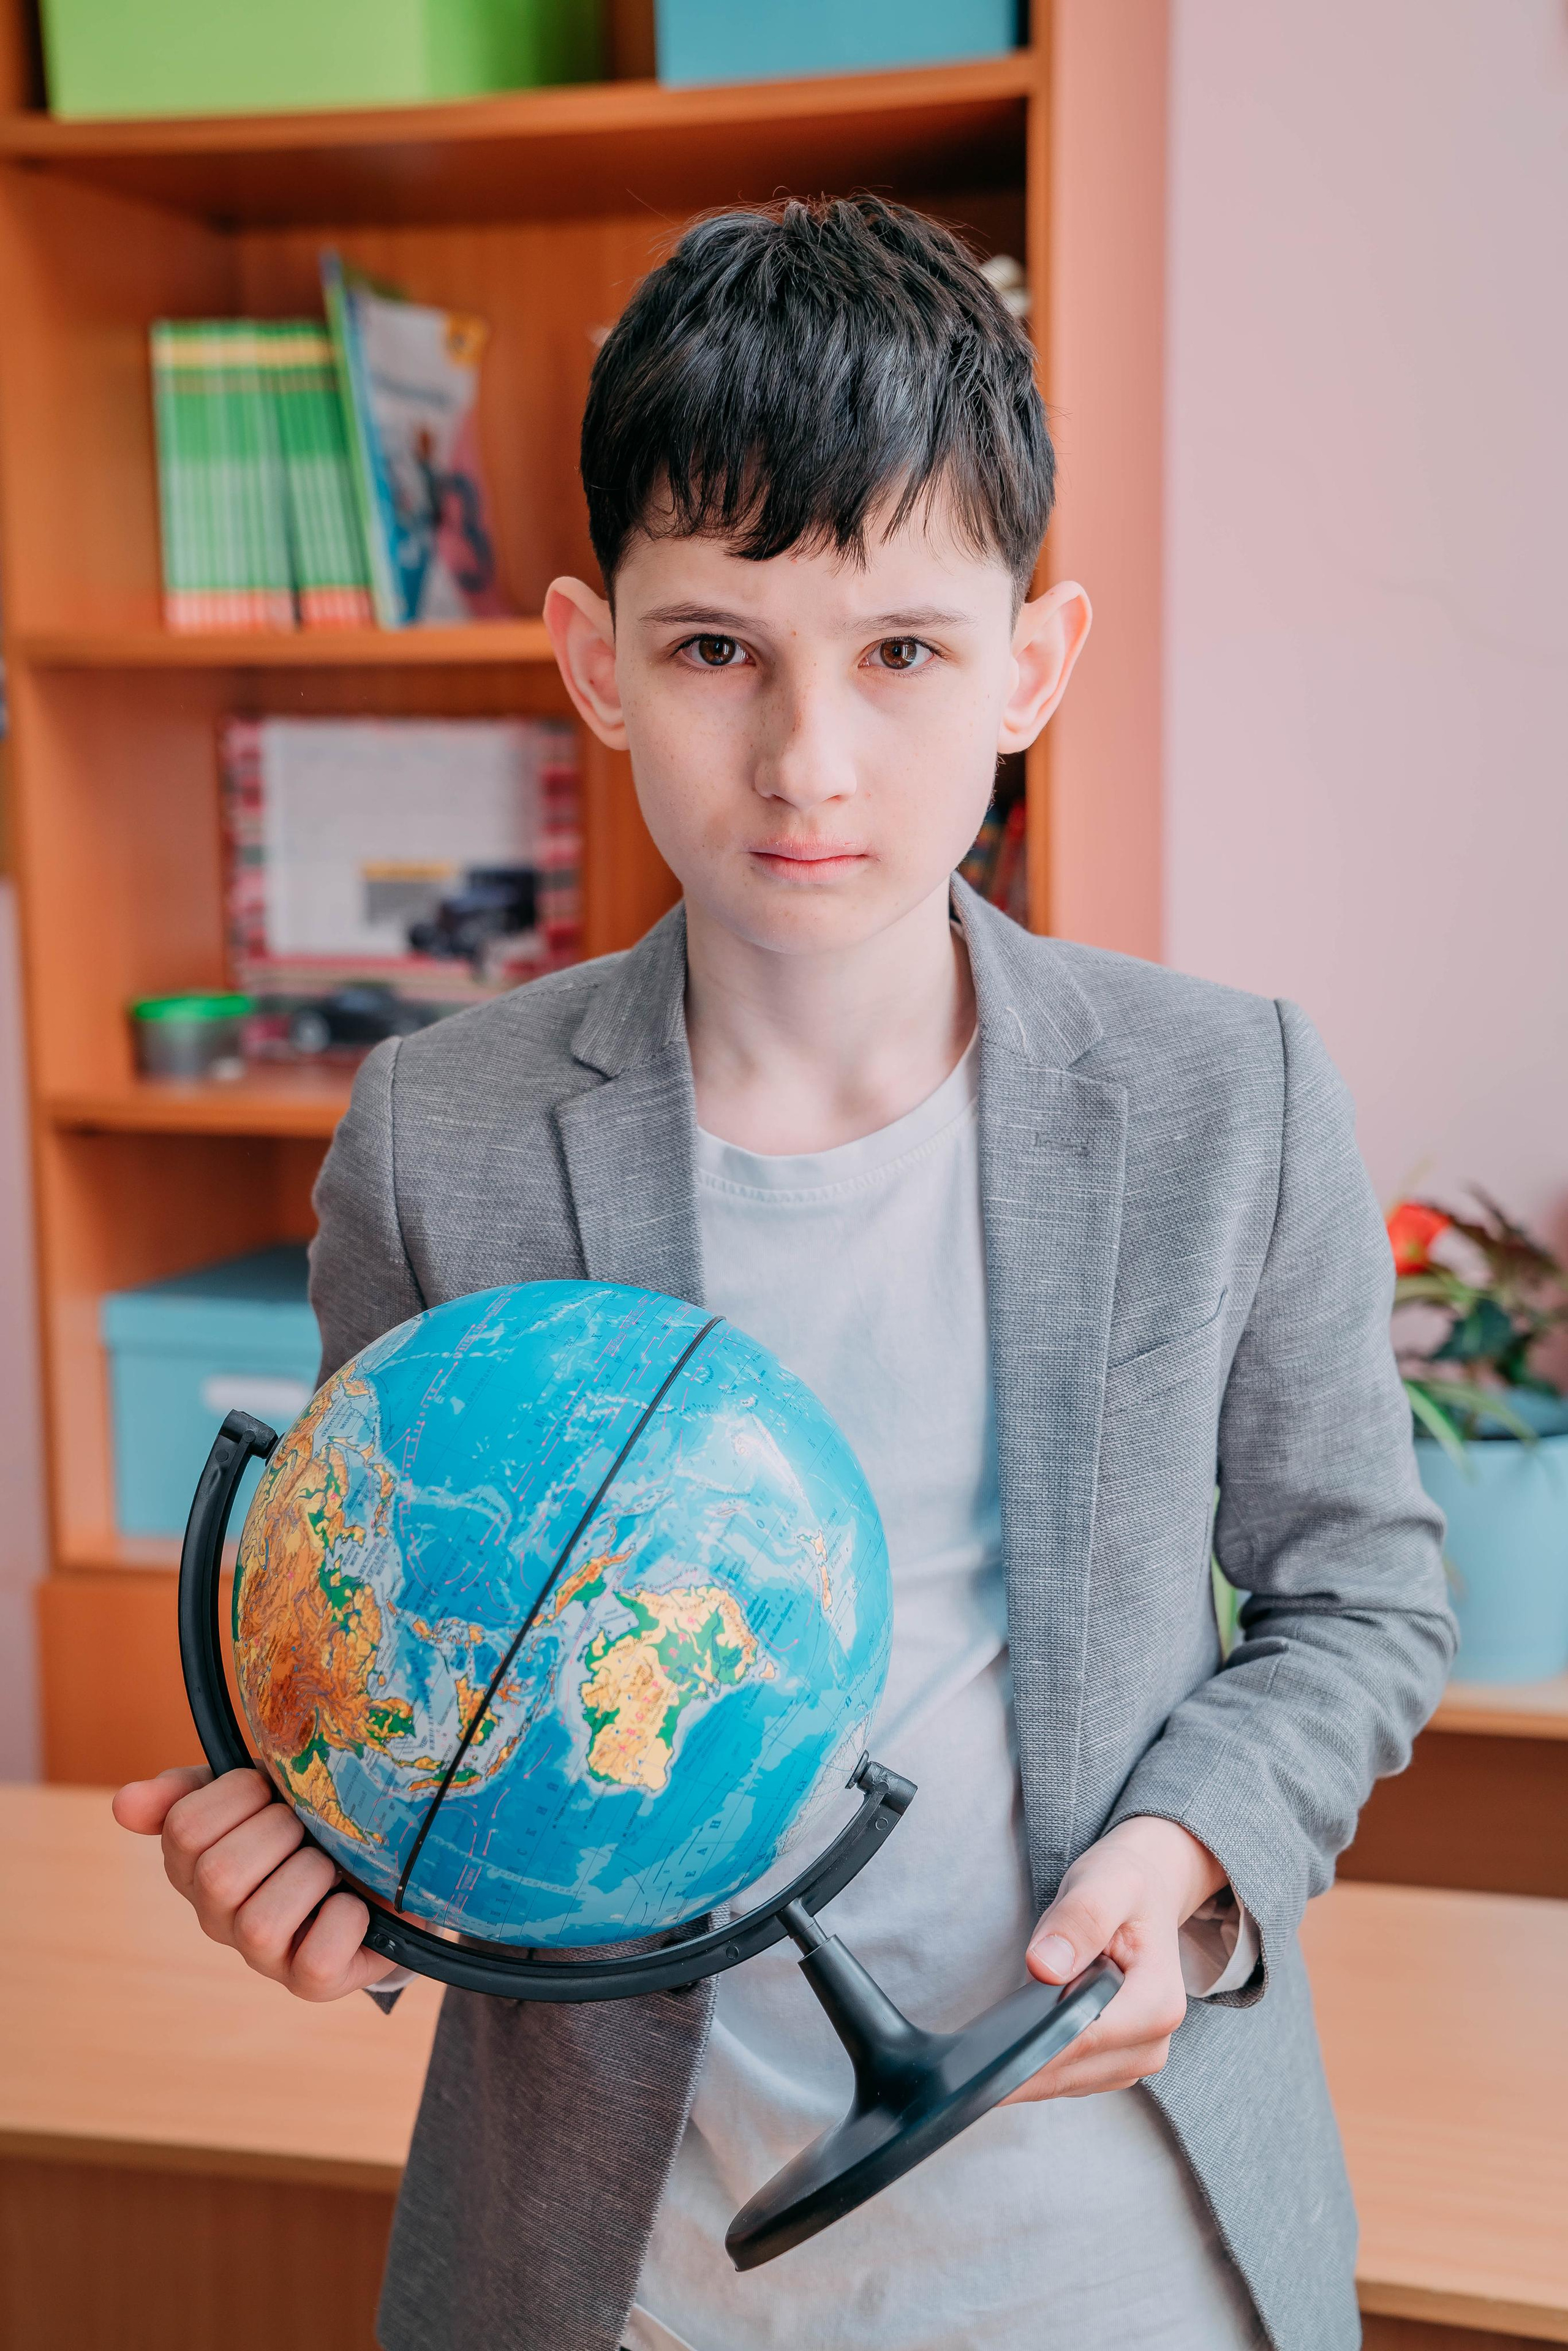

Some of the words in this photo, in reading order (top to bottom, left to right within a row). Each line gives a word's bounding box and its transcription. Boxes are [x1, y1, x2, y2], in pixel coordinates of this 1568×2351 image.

[564, 1337, 575, 1347] 20°
[321, 1402, 347, 1437] ОХОТСКОЕ
[339, 1410, 355, 1430] МОРЕ
